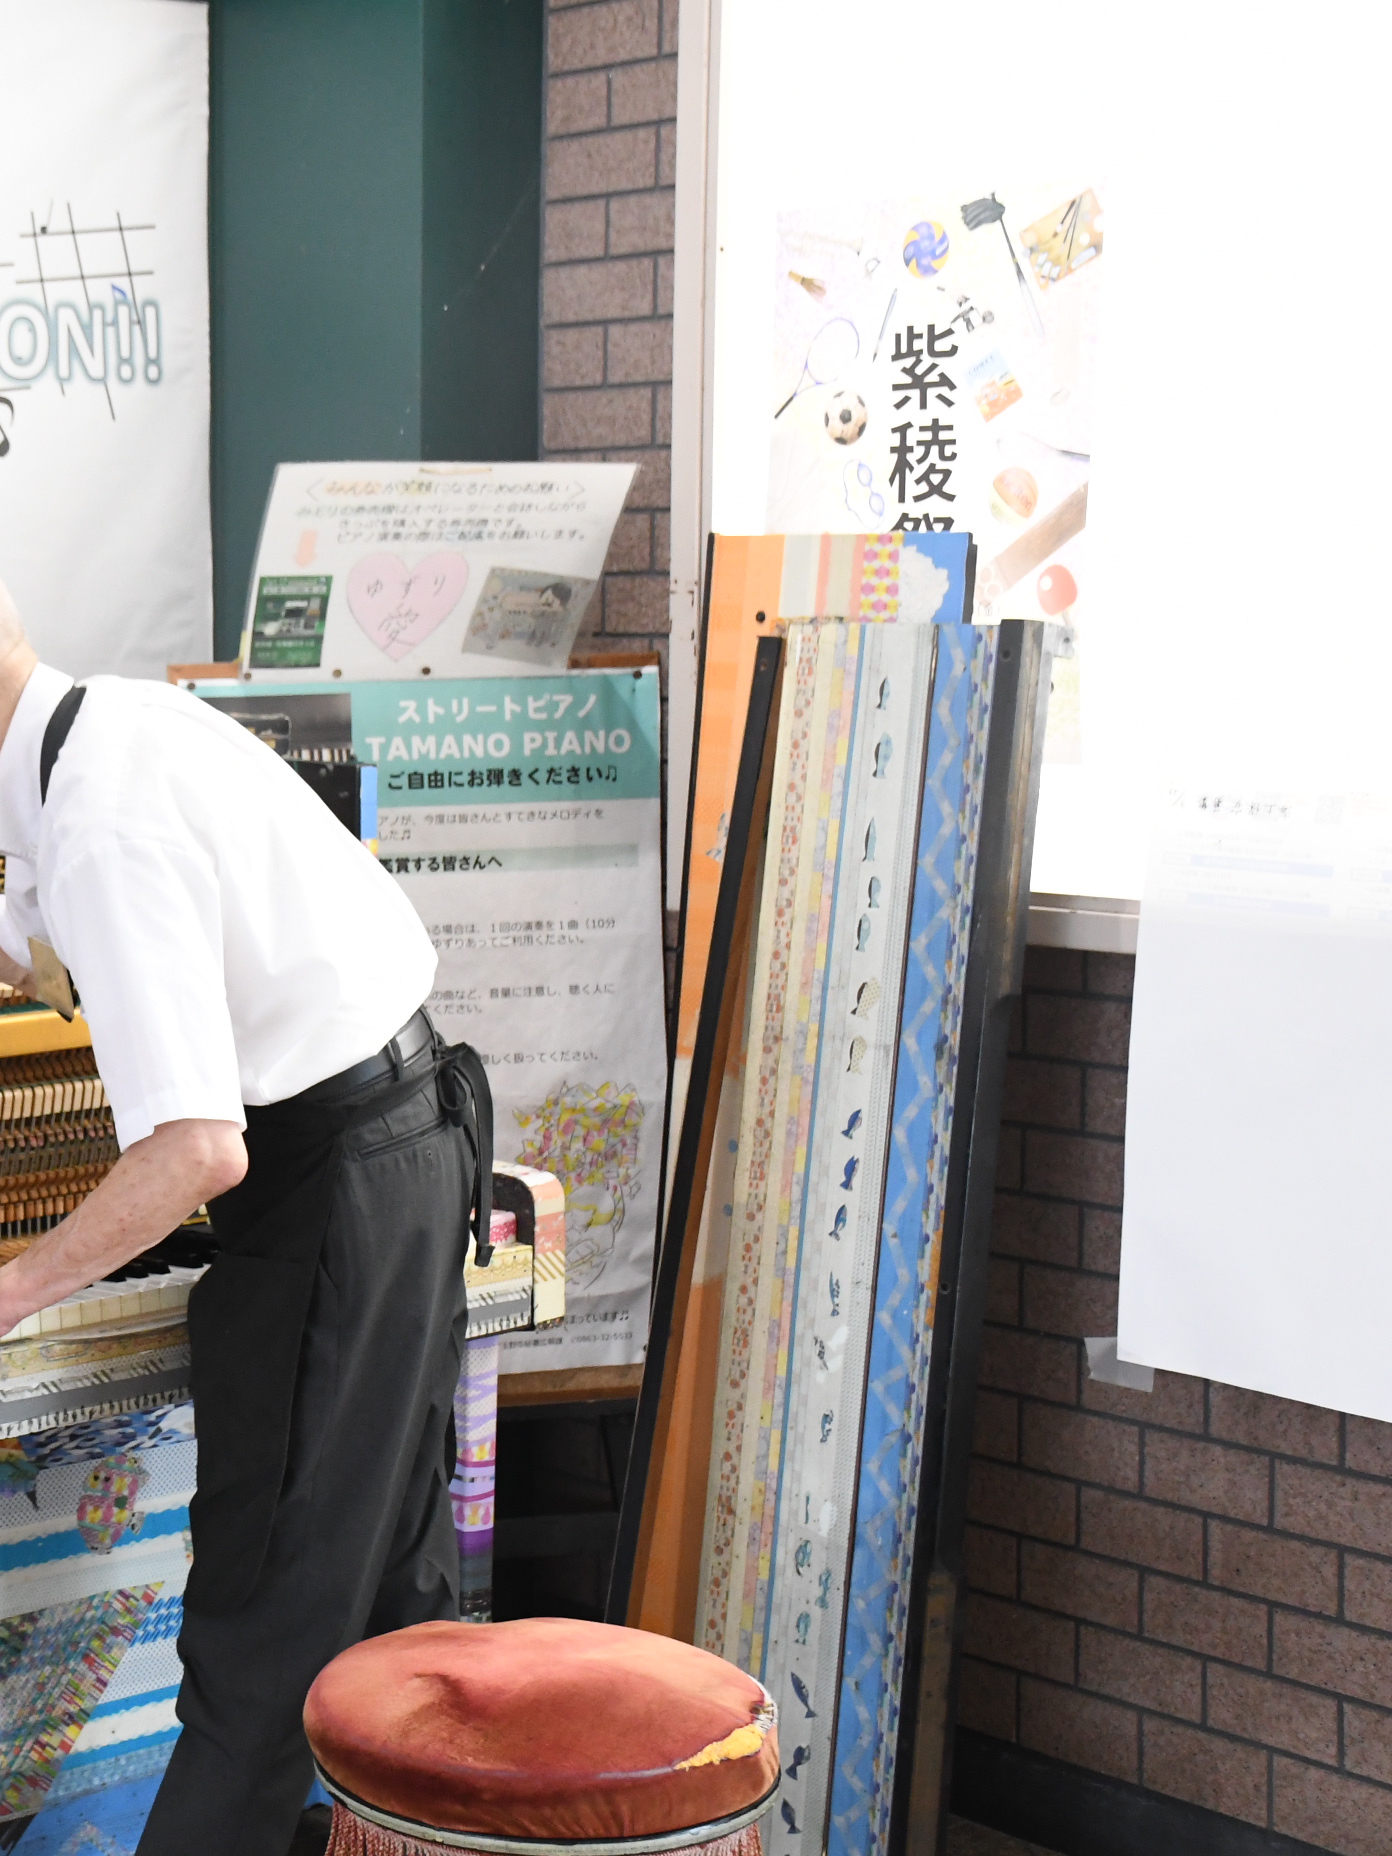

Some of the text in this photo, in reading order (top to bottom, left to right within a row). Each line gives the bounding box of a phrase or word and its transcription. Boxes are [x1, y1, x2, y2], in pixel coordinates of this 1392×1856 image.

[398, 694, 597, 724] ストリートピアノ
[365, 728, 632, 762] TAMANO PIANO
